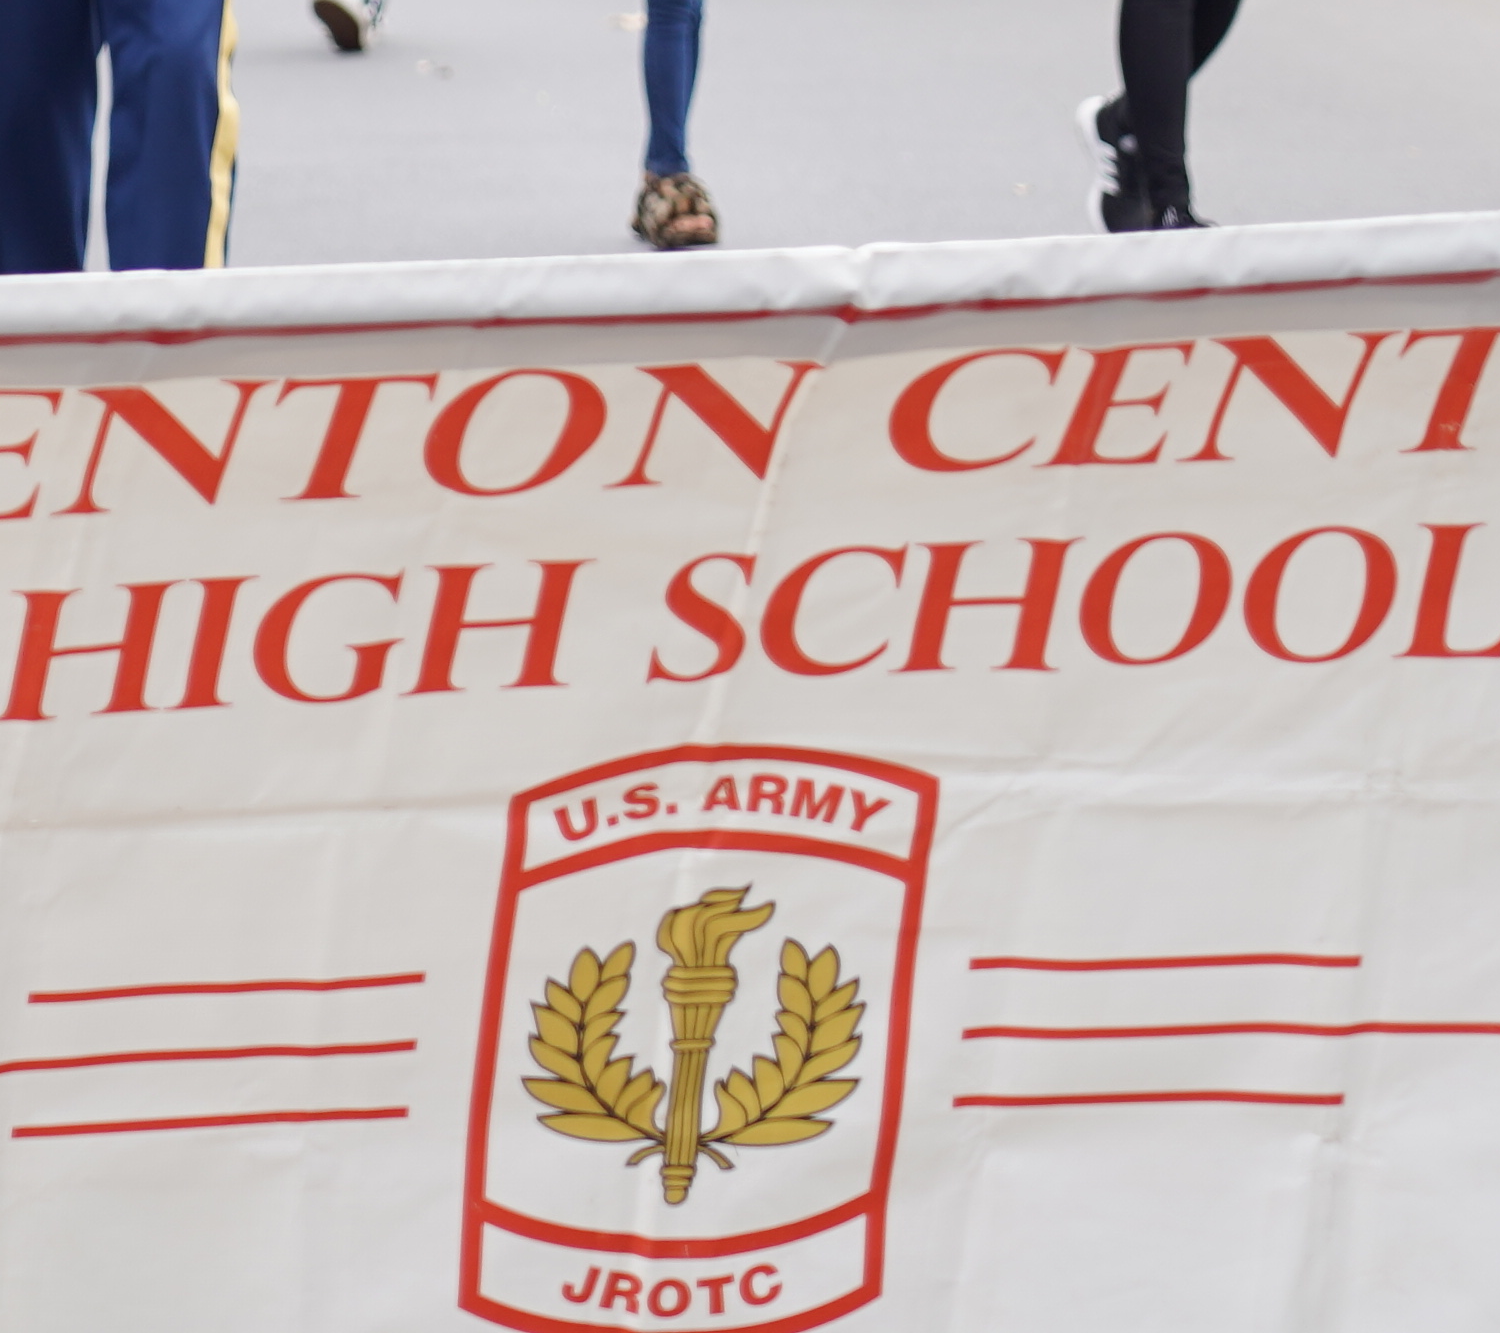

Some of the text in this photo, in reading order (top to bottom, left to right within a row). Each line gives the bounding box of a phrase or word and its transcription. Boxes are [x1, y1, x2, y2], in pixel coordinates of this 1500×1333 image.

[553, 774, 892, 842] U.S. ARMY
[562, 1264, 783, 1318] JROTC
